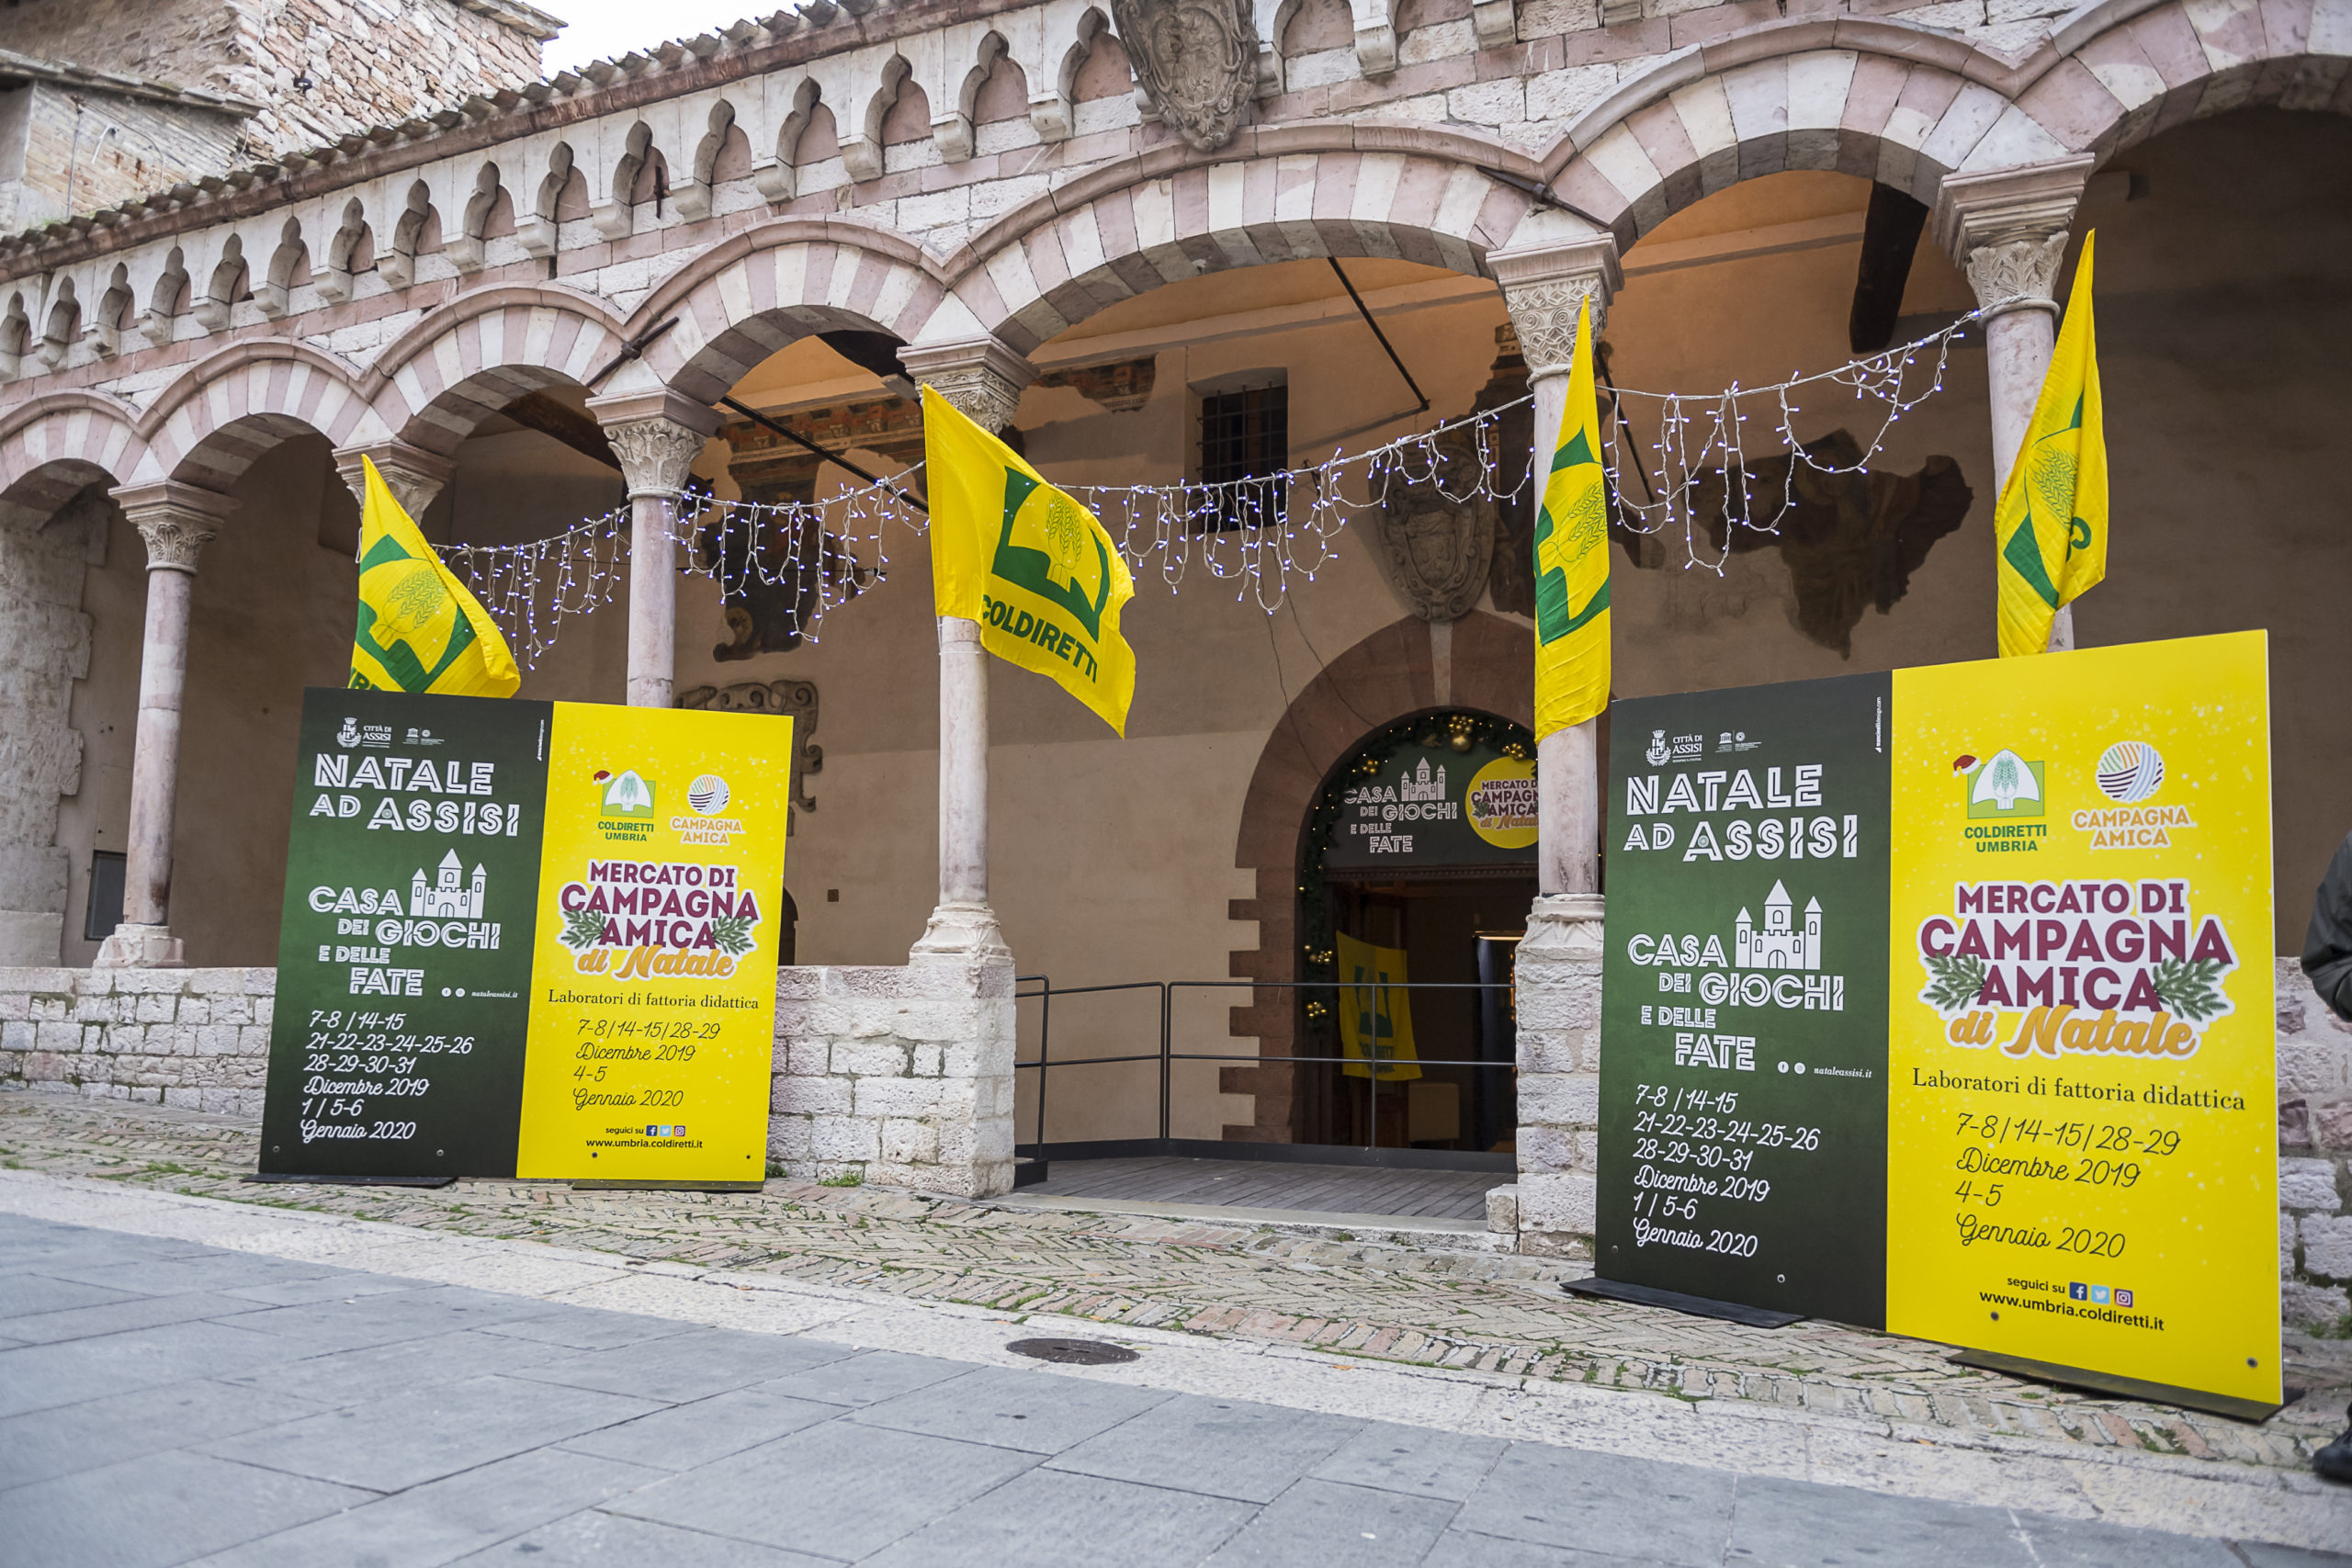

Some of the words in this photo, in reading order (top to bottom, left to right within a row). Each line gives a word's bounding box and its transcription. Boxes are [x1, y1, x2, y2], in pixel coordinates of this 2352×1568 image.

[362, 732, 391, 741] ASSISI
[363, 724, 383, 732] CITTÀ
[1672, 734, 1693, 744] CITTÀ
[1672, 743, 1702, 754] ASSISI
[314, 753, 495, 795] NATALE
[1482, 780, 1528, 790] MERCATO
[1532, 780, 1538, 788] D
[1344, 785, 1398, 805] CASA
[1471, 790, 1539, 803] CAMPAGN
[1626, 763, 1823, 816] NATALE
[309, 794, 361, 818] AD
[367, 797, 520, 837] ASSISI
[1360, 807, 1378, 818] DEI
[1382, 802, 1458, 821] GIOCHI
[1488, 802, 1537, 816] AMICA
[2074, 807, 2189, 828] CAMPAGNA
[597, 821, 654, 832] COLDIRETTI
[672, 818, 741, 831] CAMPAGNA
[1351, 824, 1357, 834] E
[1360, 823, 1392, 834] DELLE
[1496, 814, 1539, 829] Natal
[1964, 824, 2047, 840] COLDIRETTI
[605, 832, 647, 841] UMBRIA
[683, 831, 729, 843] AMICA
[1370, 835, 1413, 853] FATE
[1623, 822, 1675, 852] AD
[1682, 814, 1858, 862] ASSISI
[1976, 840, 2038, 852] UMBRIA
[2093, 829, 2169, 847] AMICA
[590, 862, 703, 886] MERCATO
[708, 868, 735, 887] DI
[308, 886, 404, 916] CASA
[561, 884, 759, 920] CAMPAGNA
[1959, 884, 2130, 914] MERCATO
[2141, 883, 2185, 914] DI
[337, 919, 370, 936] DEI
[375, 919, 501, 950] GIOCHI
[598, 917, 717, 950] AMICA
[1920, 919, 2233, 964] CAMPAGNA
[318, 945, 331, 962] E
[335, 946, 391, 964] DELLE
[577, 949, 609, 972] di
[615, 944, 735, 978] Natale
[1627, 933, 1728, 968] CASA
[349, 967, 424, 997] FATE
[1658, 972, 1691, 993] DEI
[1699, 972, 1844, 1011] GIOCHI
[1977, 964, 2165, 1012] AMICA
[548, 988, 623, 1005] Laboratori
[628, 992, 641, 1006] di
[646, 992, 696, 1007] fattoria
[700, 994, 759, 1010] didattica
[309, 1010, 342, 1029] 7-8
[1641, 1005, 1652, 1025] E
[1657, 1006, 1716, 1029] DELLE
[1950, 1010, 1994, 1045] di
[2004, 1004, 2197, 1055] Natale
[305, 1032, 475, 1055] 21-22-23-24-25-26
[575, 1042, 651, 1061] Dicembre
[654, 1044, 696, 1062] 2019
[1675, 1032, 1756, 1071] FATE
[303, 1054, 417, 1074] 28-29-30-31
[573, 1065, 608, 1082] 4-5
[1814, 1066, 1872, 1078] nataleassisi.it
[303, 1075, 383, 1096] Dicembre
[385, 1077, 430, 1097] 2019
[1635, 1084, 1668, 1108] 7-8
[1913, 1067, 2020, 1093] Laboratori
[2027, 1076, 2047, 1096] di
[2053, 1078, 2135, 1102] fattoria
[2143, 1084, 2245, 1111] didattica
[301, 1098, 313, 1116] 1
[330, 1099, 365, 1117] 5-6
[572, 1088, 637, 1111] Gennaio
[639, 1089, 684, 1107] 2020
[300, 1119, 368, 1144] Gennaio
[368, 1121, 416, 1140] 2020
[605, 1126, 634, 1135] seguici
[1633, 1111, 1821, 1151] 21-22-23-24-25-26
[585, 1138, 704, 1149] www.umbria.coldiretti.it
[1632, 1137, 1754, 1171] 28-29-30-31
[1956, 1146, 2069, 1180] Dicembre
[2075, 1159, 2141, 1188] 2019
[1634, 1165, 1718, 1195] Dicembre
[1720, 1176, 1770, 1201] 2019
[1955, 1180, 2004, 1207] 4-5
[1634, 1191, 1645, 1212] 1
[1662, 1196, 1699, 1220] 5-6
[1633, 1216, 1703, 1247] Gennaio
[1705, 1229, 1758, 1258] 2020
[1956, 1213, 2051, 1247] Gennaio
[2056, 1227, 2126, 1258] 2020
[2007, 1277, 2049, 1292] seguici
[2051, 1283, 2065, 1294] su
[1979, 1291, 2165, 1331] www.umbria.coldiretti.it
